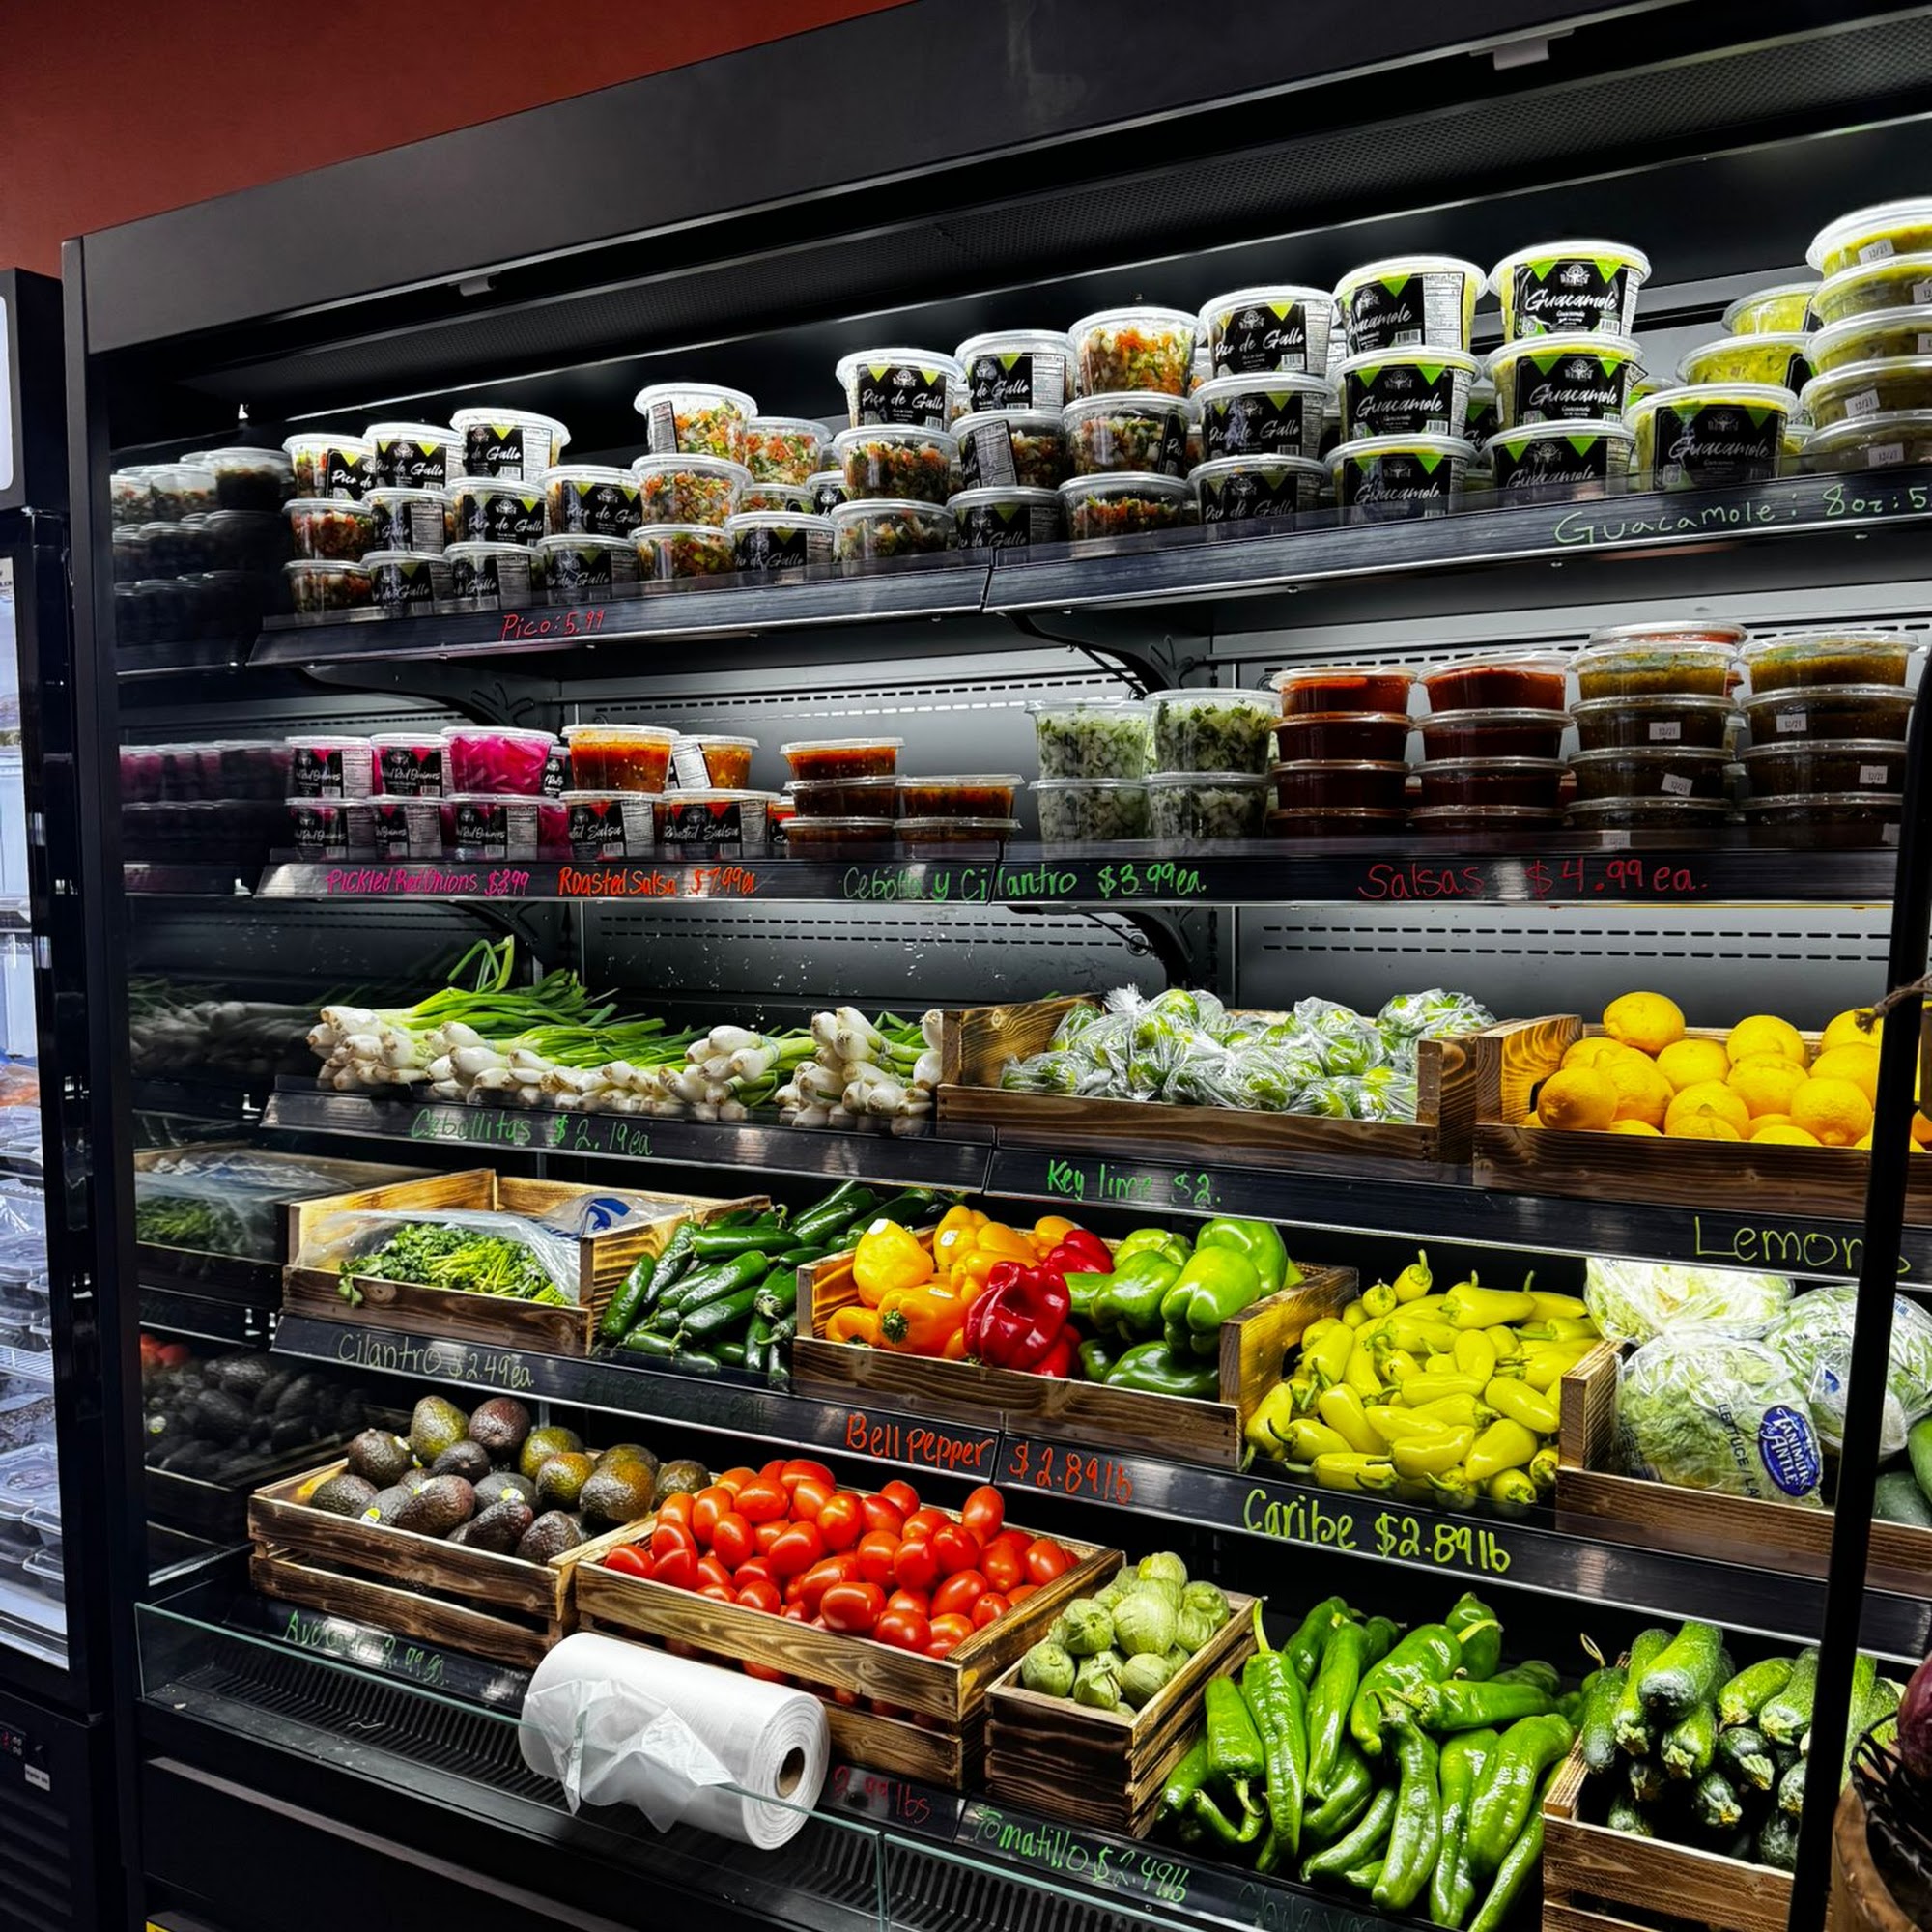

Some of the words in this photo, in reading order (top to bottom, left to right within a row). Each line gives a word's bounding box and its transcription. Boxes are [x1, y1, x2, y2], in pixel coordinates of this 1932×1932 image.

[1524, 288, 1617, 311] Guacamole
[1238, 334, 1256, 351] de
[1262, 327, 1304, 349] Gallo
[861, 388, 886, 407] Pico
[891, 388, 907, 406] de
[911, 392, 945, 411] Gallo
[992, 382, 1030, 398] Gallo
[1528, 384, 1618, 406] Guacamole
[1355, 393, 1444, 418] Guacamole
[1259, 419, 1300, 439] Gallo
[486, 445, 522, 462] Gallo
[1668, 433, 1771, 459] Guacamole
[331, 469, 357, 486] Pico
[411, 461, 444, 477] Gallo
[1504, 464, 1597, 490] Guacamole
[1353, 482, 1440, 505] Guacamole
[595, 505, 611, 520] de
[1252, 500, 1294, 519] Gallo
[495, 517, 509, 532] de
[514, 518, 543, 533] Gallo
[988, 530, 1027, 547] Gallo
[765, 552, 805, 568] Gallo
[397, 583, 430, 599] Gallo
[574, 573, 611, 587] Gallo
[586, 823, 622, 839] Salsa
[703, 824, 739, 840] Salsa
[396, 867, 423, 895] Red
[424, 867, 479, 894] Onions
[557, 866, 628, 896] Roasted
[629, 869, 677, 896] Salsa
[929, 870, 950, 903] y
[960, 864, 1078, 901] Cilantro
[1357, 860, 1486, 900] Salsas
[1047, 1158, 1085, 1202] Key
[1098, 1163, 1152, 1199] lime
[337, 1332, 442, 1374] Cilantro
[845, 1412, 900, 1460] Bell
[1759, 1430, 1800, 1486] ANTLE
[1243, 1488, 1357, 1550] Caribe
[972, 1806, 1089, 1872] Tomatillo
